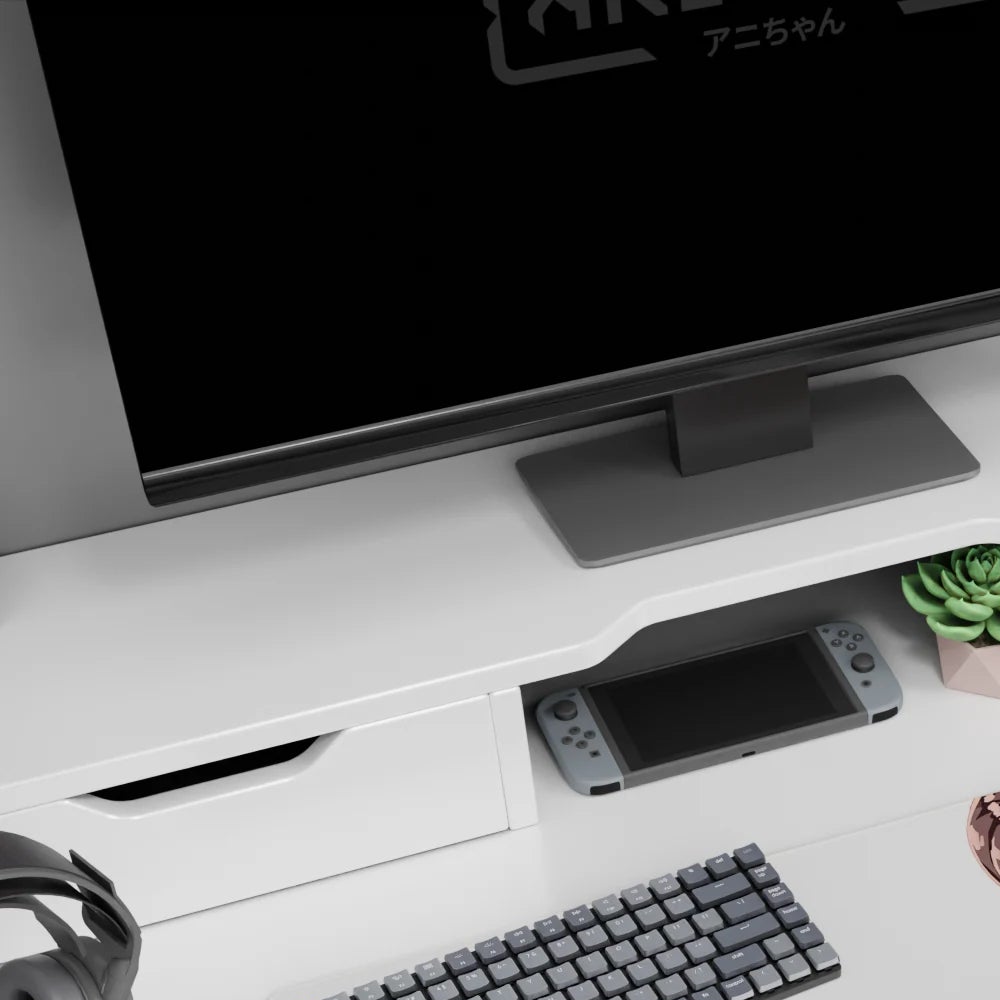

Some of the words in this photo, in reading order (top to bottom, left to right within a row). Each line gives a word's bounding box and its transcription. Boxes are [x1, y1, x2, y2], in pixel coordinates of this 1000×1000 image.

[703, 7, 846, 58] アニちゃん
